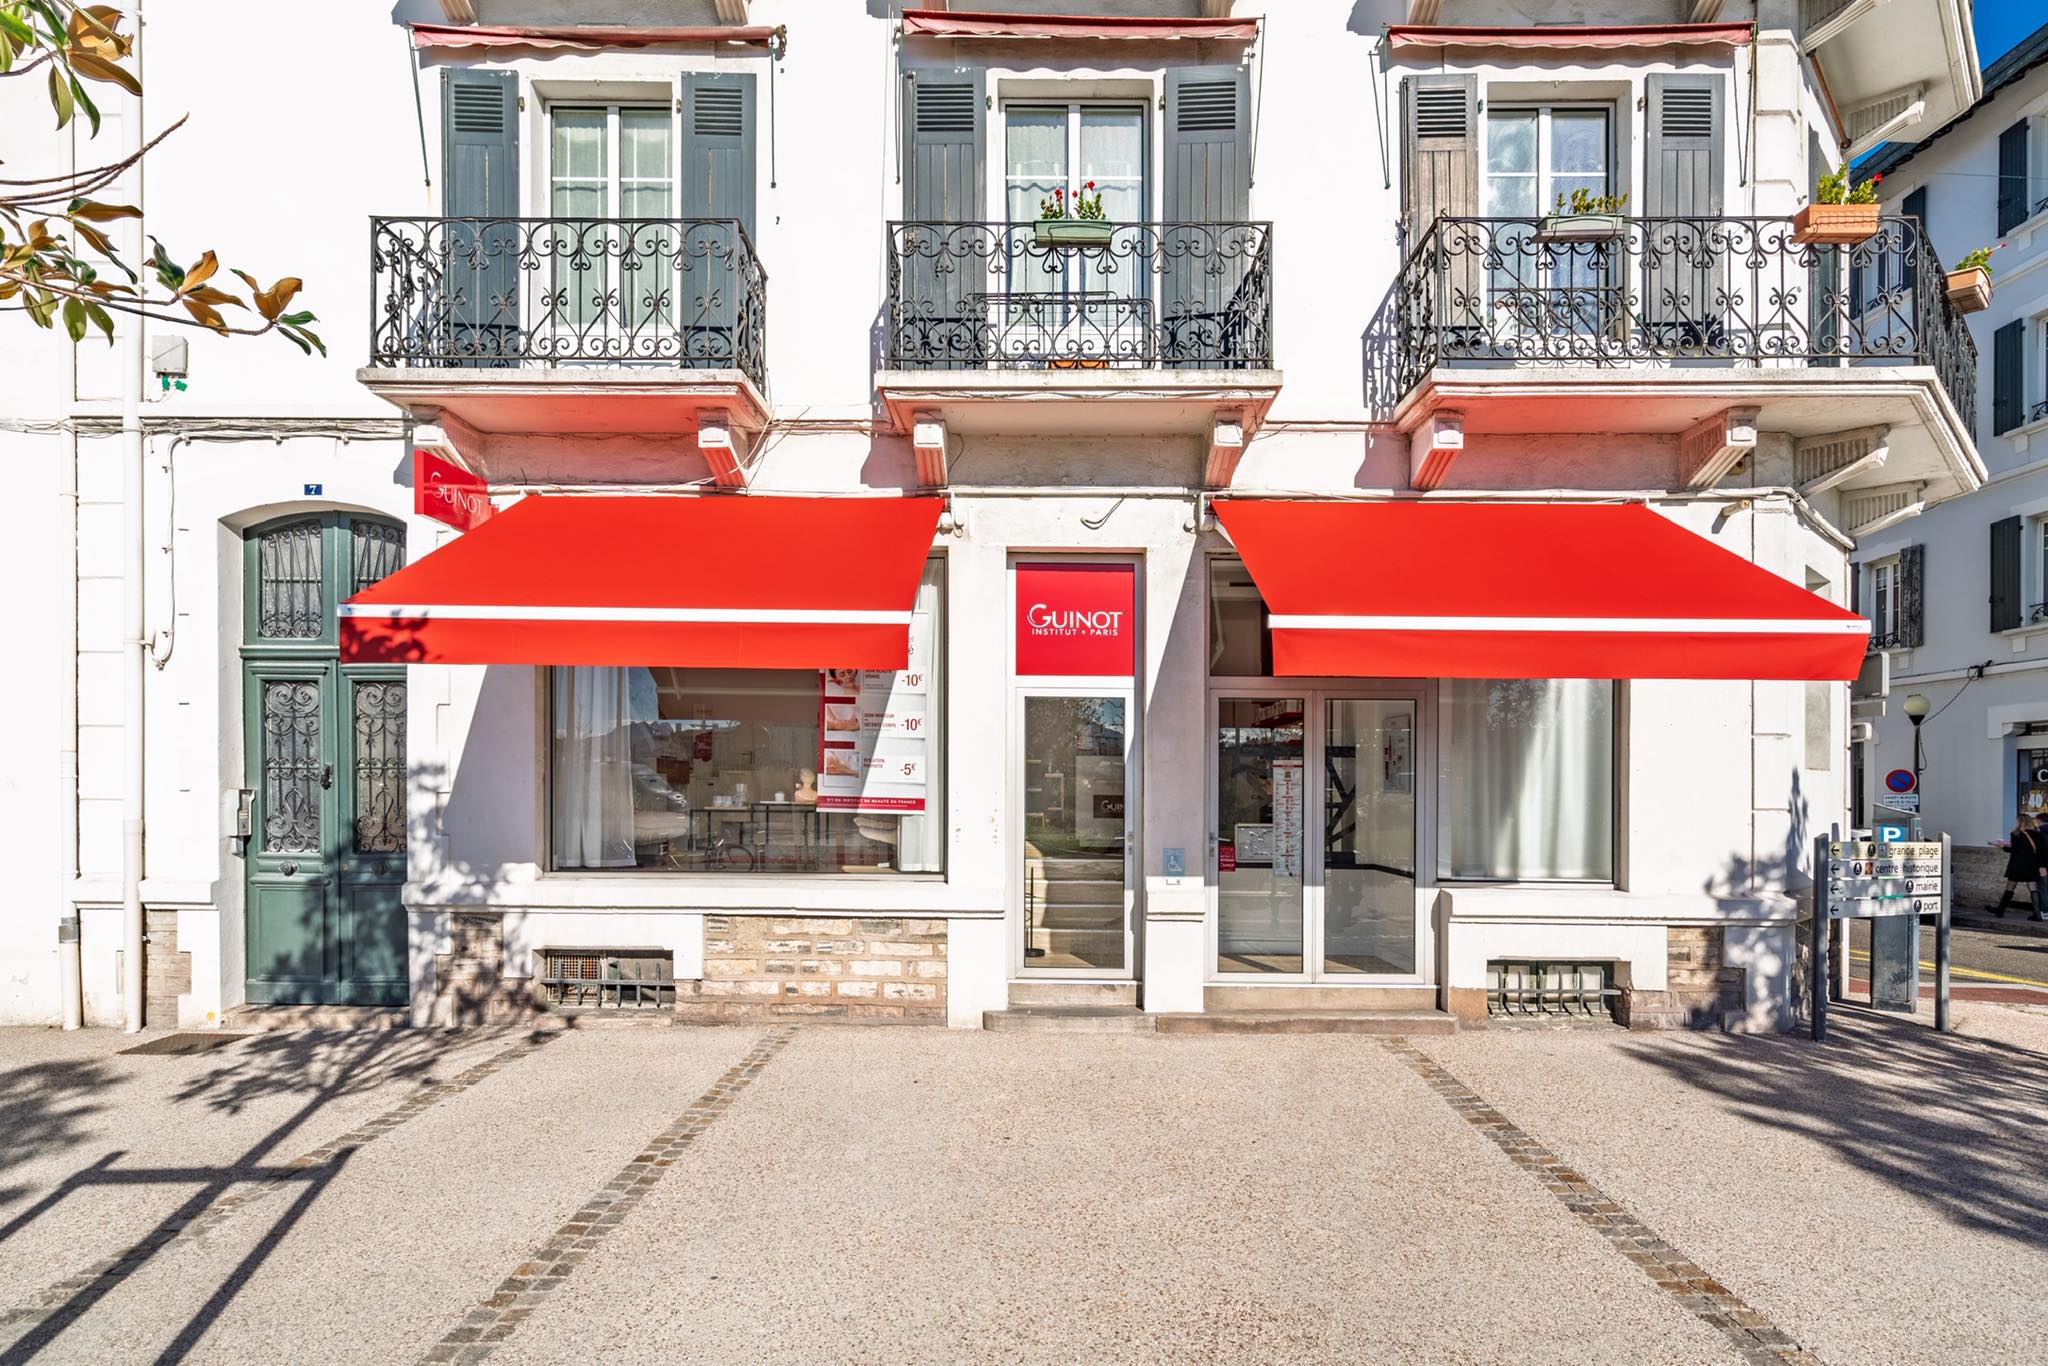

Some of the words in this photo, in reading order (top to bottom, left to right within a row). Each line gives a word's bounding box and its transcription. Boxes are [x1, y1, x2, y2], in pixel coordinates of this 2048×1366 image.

[308, 485, 317, 495] 7
[430, 471, 483, 515] GUINOT
[1026, 603, 1123, 629] GUINOT
[1883, 827, 1901, 842] P
[1888, 845, 1915, 858] grande
[1919, 844, 1939, 858] plage
[1875, 864, 1899, 873] centre
[1903, 861, 1939, 874] historique
[1915, 882, 1938, 891] mairie
[1923, 901, 1938, 911] port
